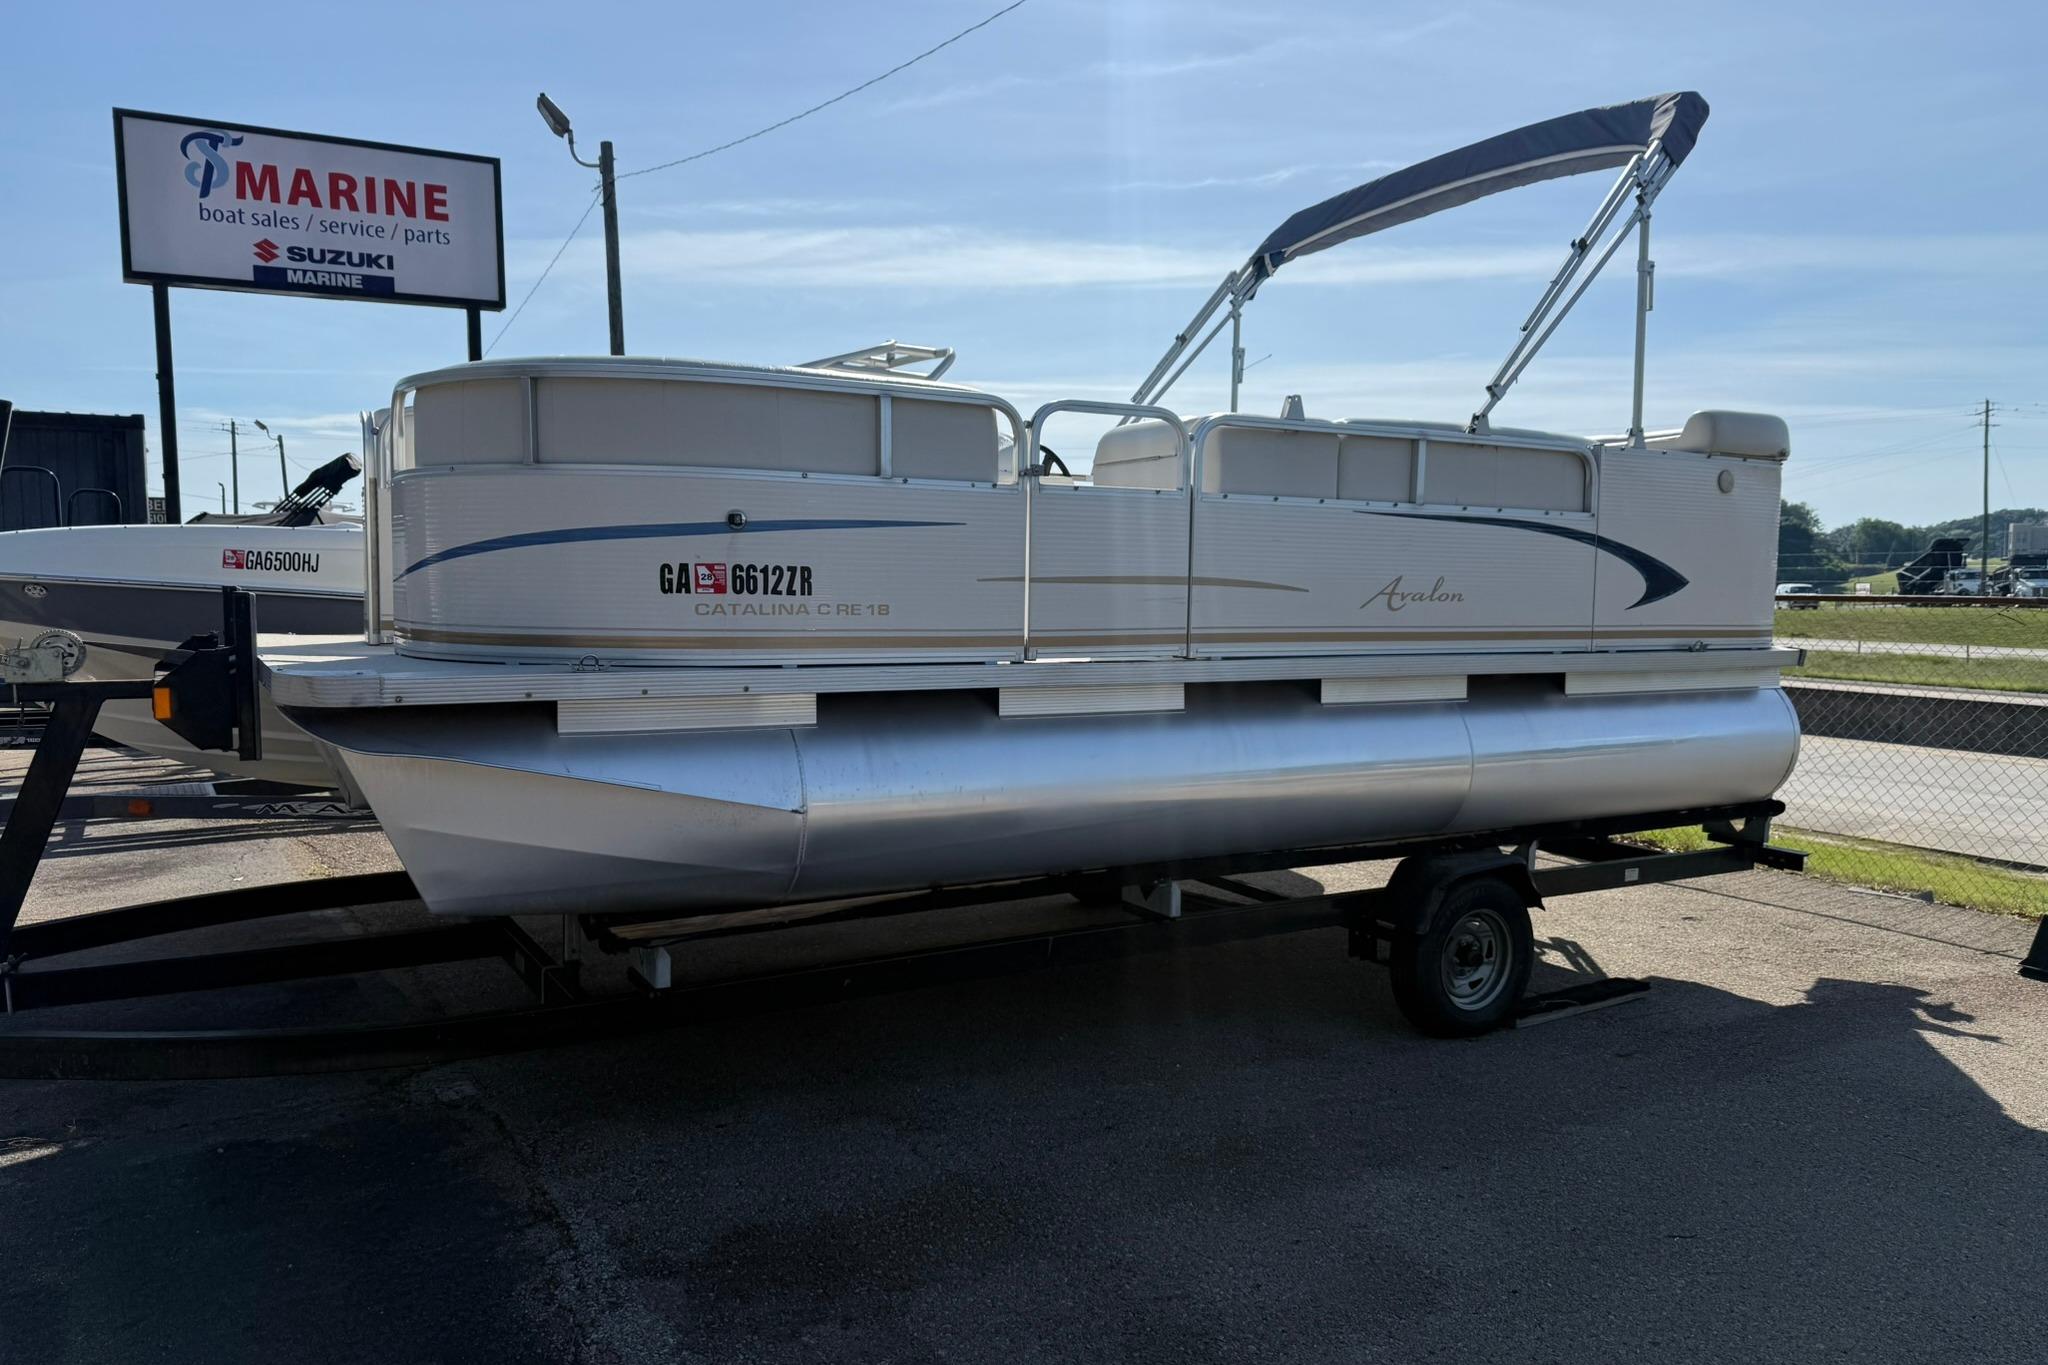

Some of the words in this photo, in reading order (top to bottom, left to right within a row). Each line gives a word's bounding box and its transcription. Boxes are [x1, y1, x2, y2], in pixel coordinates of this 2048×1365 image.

[236, 161, 449, 222] MARINE
[199, 202, 245, 225] boat
[251, 209, 300, 231] sales
[320, 218, 385, 239] service
[404, 226, 451, 247] parts
[286, 245, 394, 271] SUZUKI
[287, 269, 364, 290] MARINE
[245, 550, 320, 573] GA6500HJ
[660, 563, 691, 594] GA
[700, 573, 713, 581] 28
[731, 563, 813, 596] 6612ZR
[1360, 575, 1464, 611] Avalon
[695, 603, 810, 616] CATALINA
